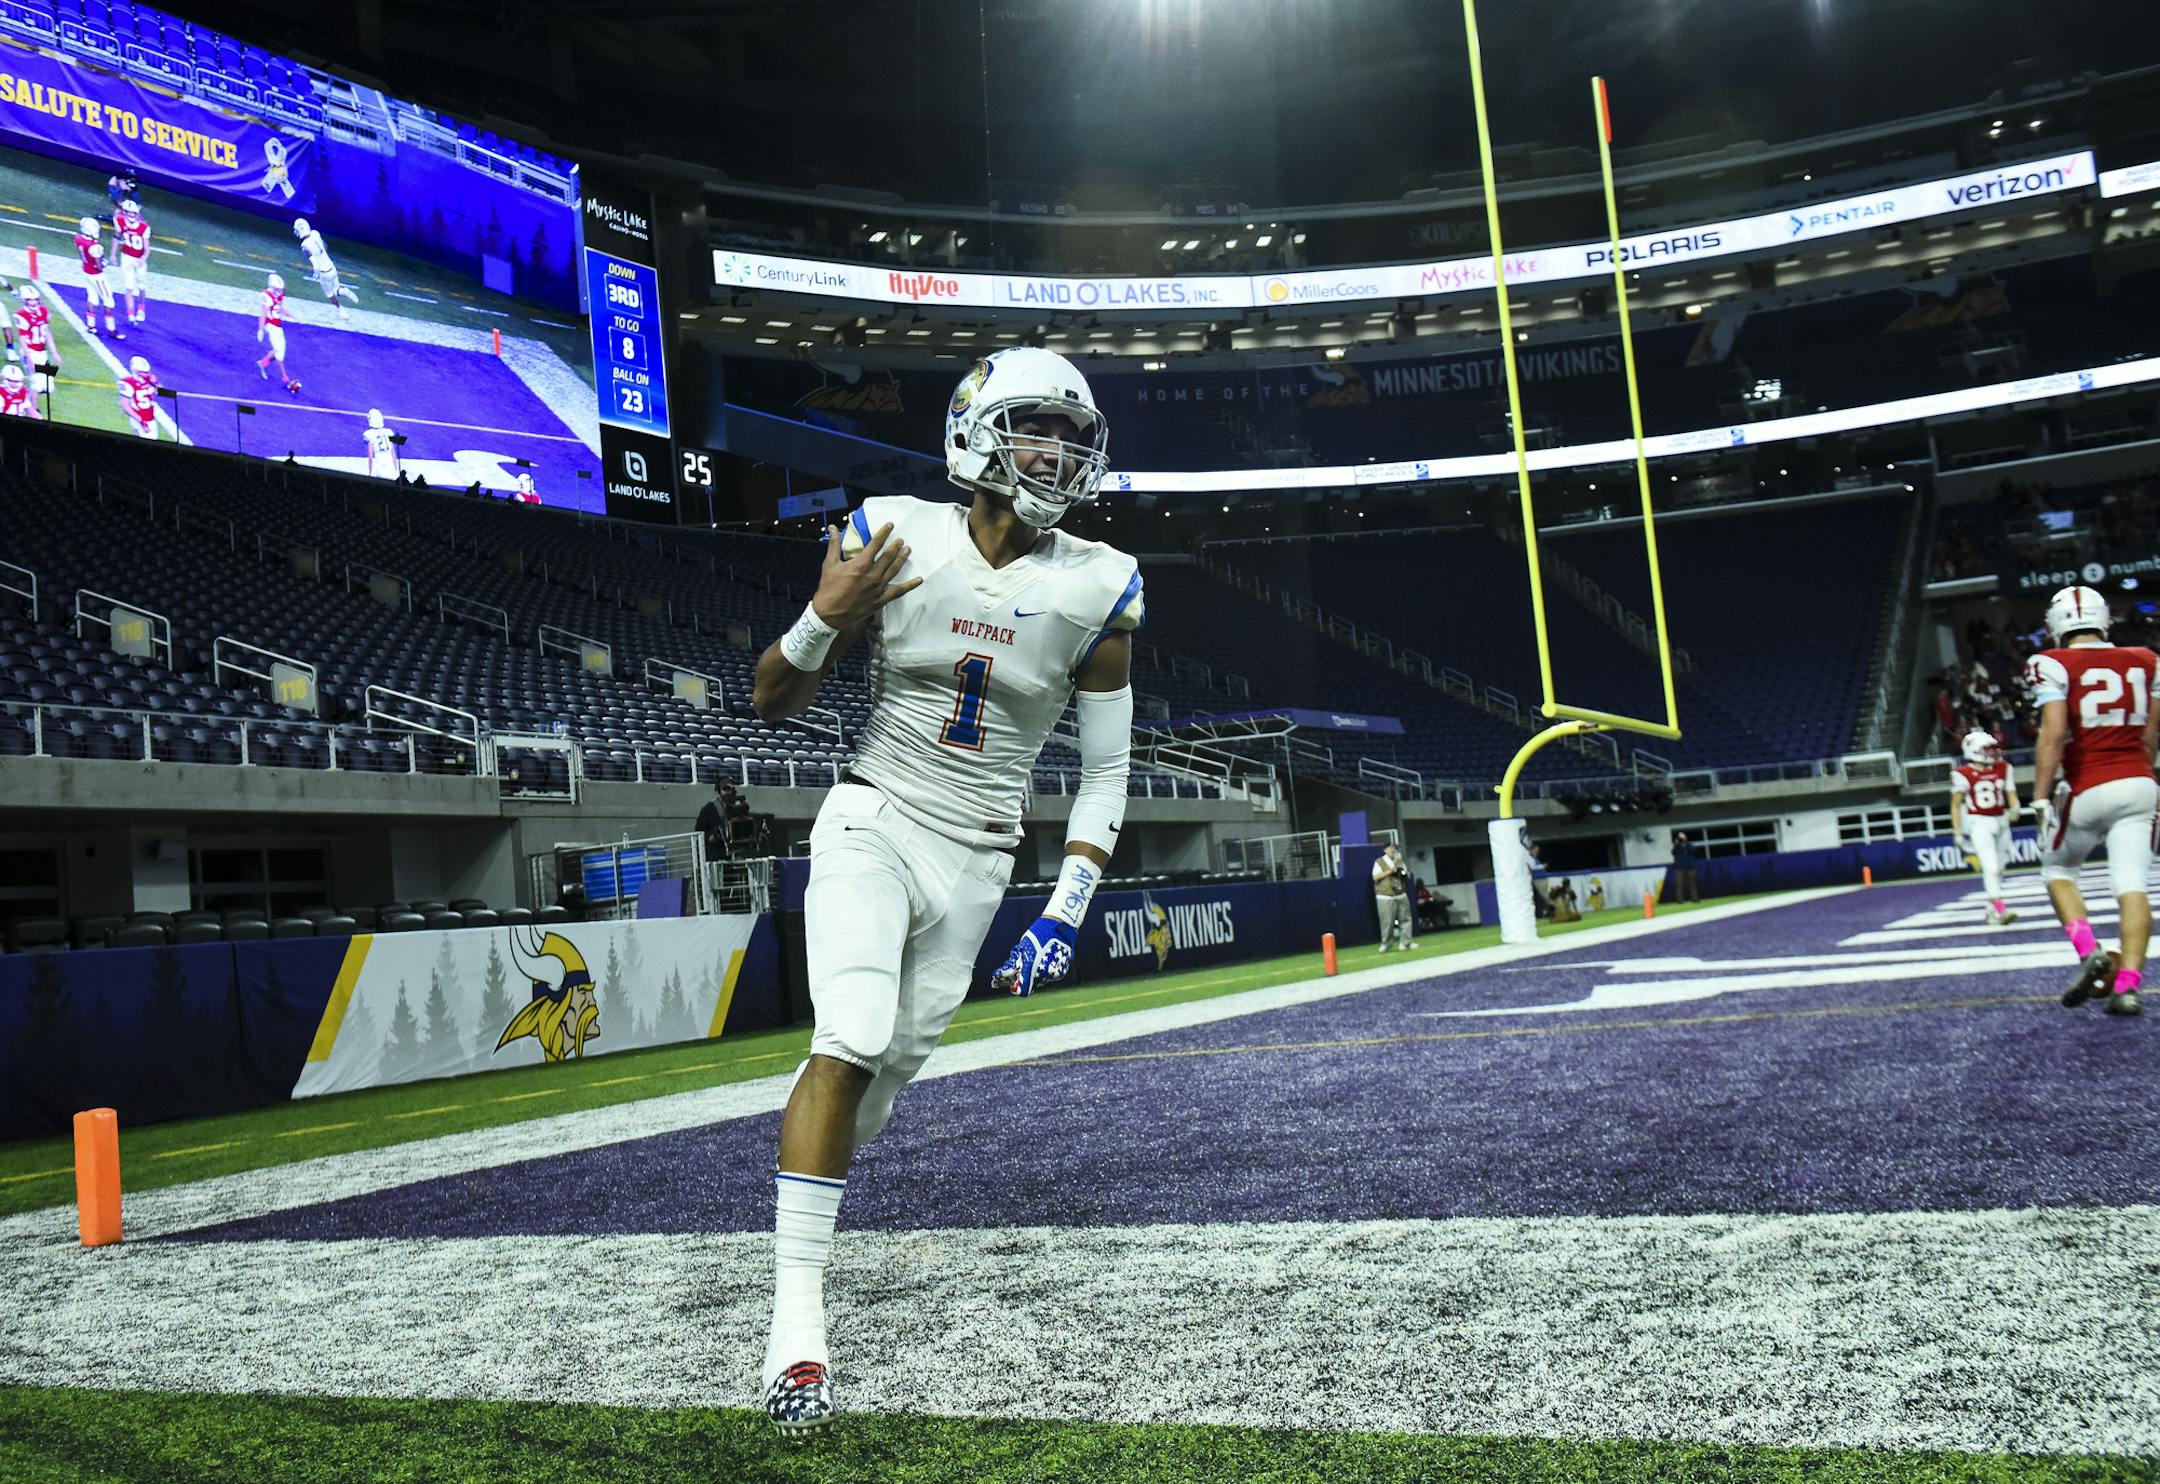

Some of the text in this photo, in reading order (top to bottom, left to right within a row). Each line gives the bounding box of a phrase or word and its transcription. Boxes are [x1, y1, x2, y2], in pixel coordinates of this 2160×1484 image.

[0, 73, 239, 169] SALUTE TO SERVICE
[1947, 168, 2064, 206] verizon
[1809, 200, 1896, 229] PENTAIR
[1586, 231, 1722, 268] POLARIS
[608, 262, 636, 281] DOWN
[757, 264, 848, 288] CenturyLink
[608, 283, 640, 308] 3RD
[888, 272, 960, 301] HyVee
[1008, 281, 1071, 304] LAND
[1292, 282, 1379, 300] MillerCoors
[614, 315, 626, 329] TO
[622, 336, 635, 360] 8
[612, 366, 650, 386] BALL ON
[1516, 345, 1620, 383] VIKINGS
[621, 387, 644, 414] 23
[1137, 384, 1309, 402] HOME OF THE
[683, 451, 713, 487] 25
[608, 482, 633, 495] LAND
[2020, 570, 2078, 587] sleep
[951, 617, 1016, 646] WOLFPACK
[938, 652, 994, 752] 1
[2080, 667, 2148, 728] 21
[1916, 846, 1968, 872] SKOL
[1104, 901, 1235, 958] SKOL VIKINGS
